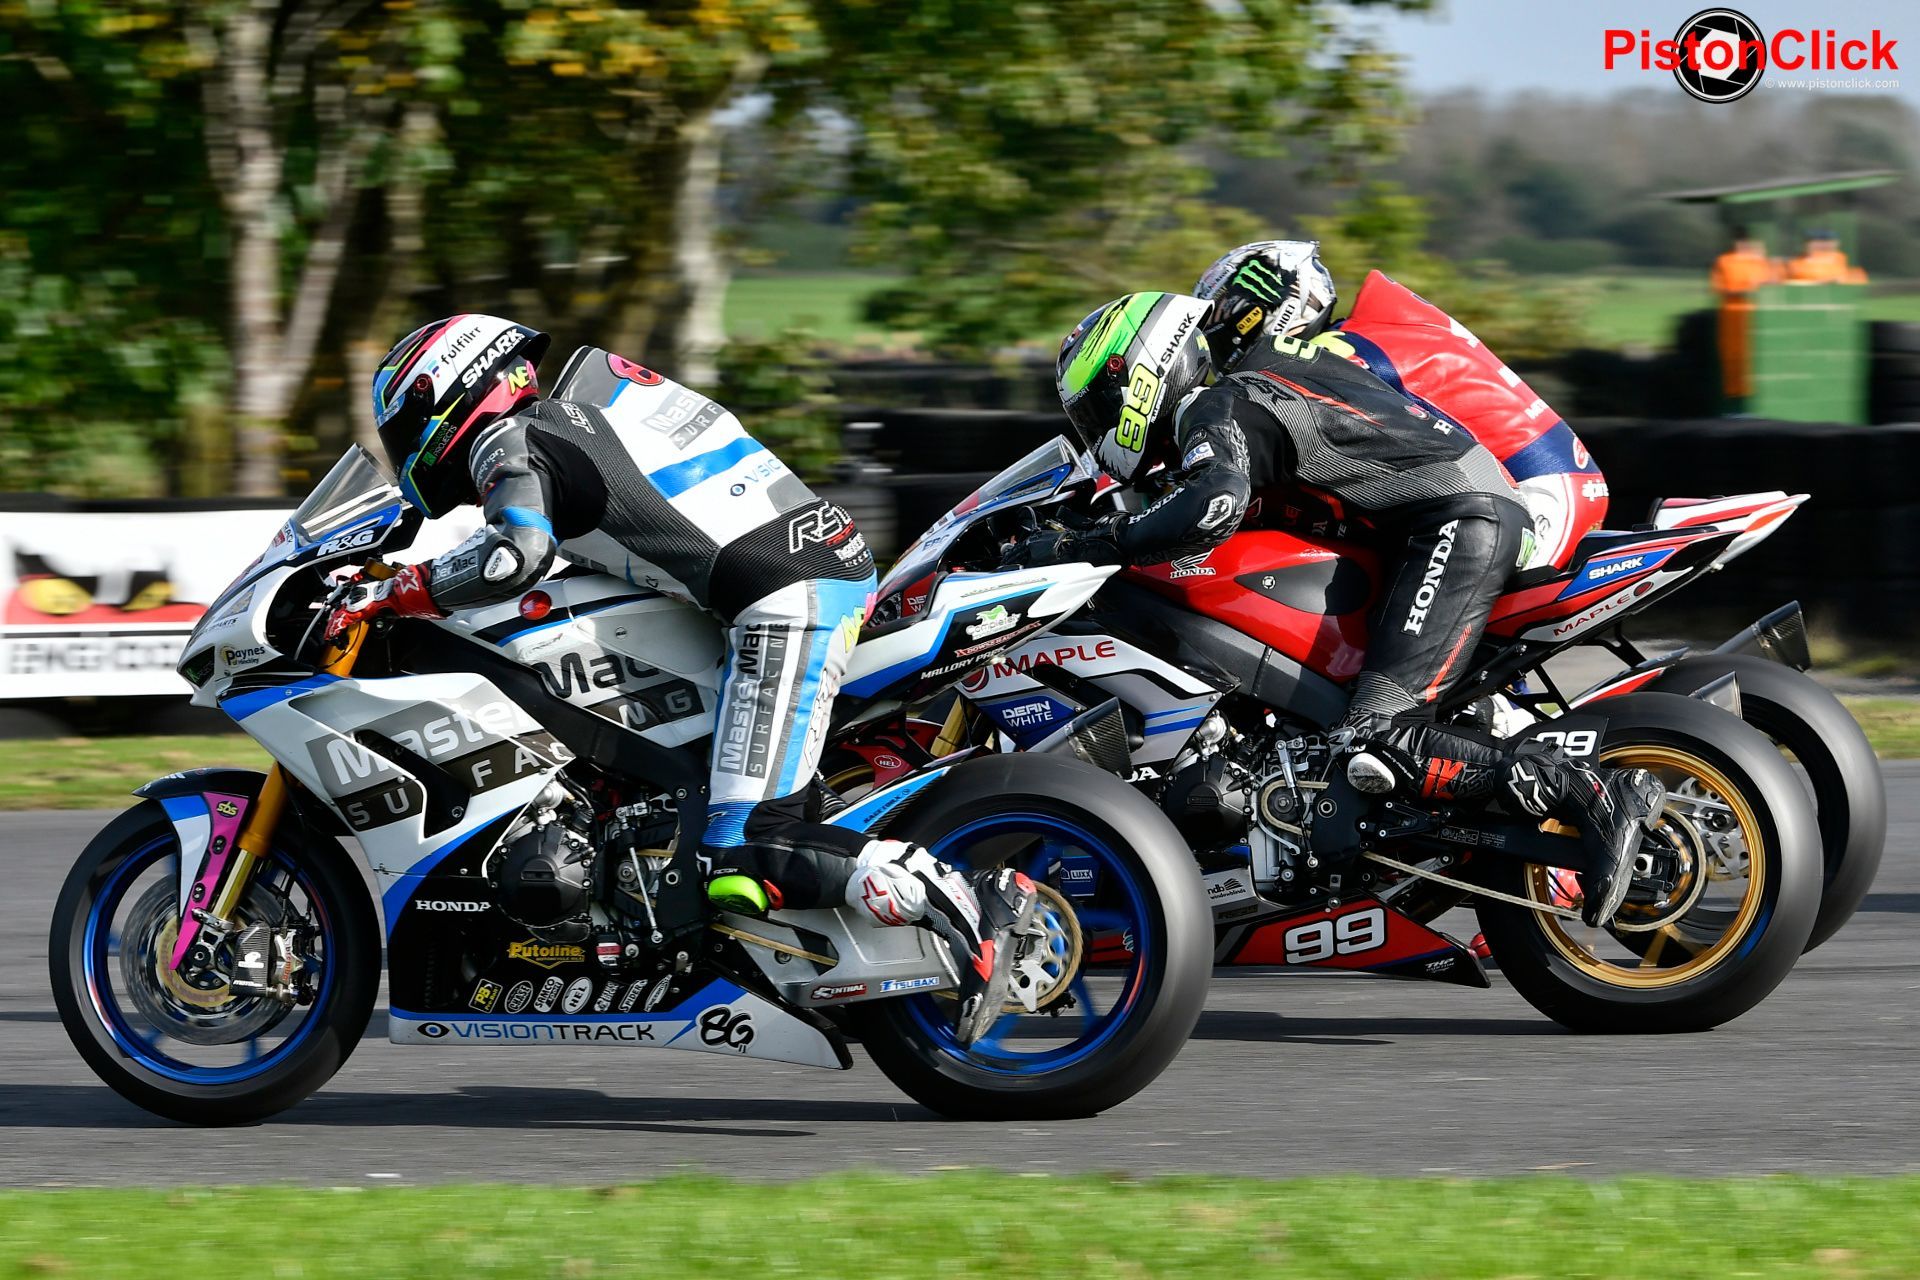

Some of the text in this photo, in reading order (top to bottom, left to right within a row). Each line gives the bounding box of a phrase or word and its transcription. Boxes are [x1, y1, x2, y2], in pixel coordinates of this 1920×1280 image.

[1274, 304, 1296, 333] SHOEI
[1161, 312, 1196, 365] SHARK
[461, 329, 524, 389] SHARK
[1115, 363, 1160, 454] 99
[434, 425, 458, 457] PROJECTS
[1128, 487, 1185, 525] HONDA
[317, 530, 375, 557] R&G
[1170, 567, 1216, 579] HONDA
[1404, 519, 1459, 636] HONDA
[1588, 556, 1644, 580] SHARK
[1553, 594, 1631, 637] MAPLE
[226, 646, 266, 666] Paynes
[921, 655, 972, 681] MALLORY
[994, 641, 1116, 680] MAPLE
[1002, 699, 1050, 719] DEAN
[1006, 711, 1054, 729] WHITE
[879, 759, 896, 768] HEL
[1207, 884, 1225, 894] ndb
[415, 900, 492, 913] HONDA
[1285, 907, 1386, 965] 99
[508, 941, 583, 959] Putoline
[535, 978, 556, 1008] SAMCO
[570, 986, 588, 1008] HEL
[890, 977, 940, 991] TSUBAKI
[620, 983, 644, 1013] SPIDER
[451, 1022, 656, 1042] VISIONTRACK
